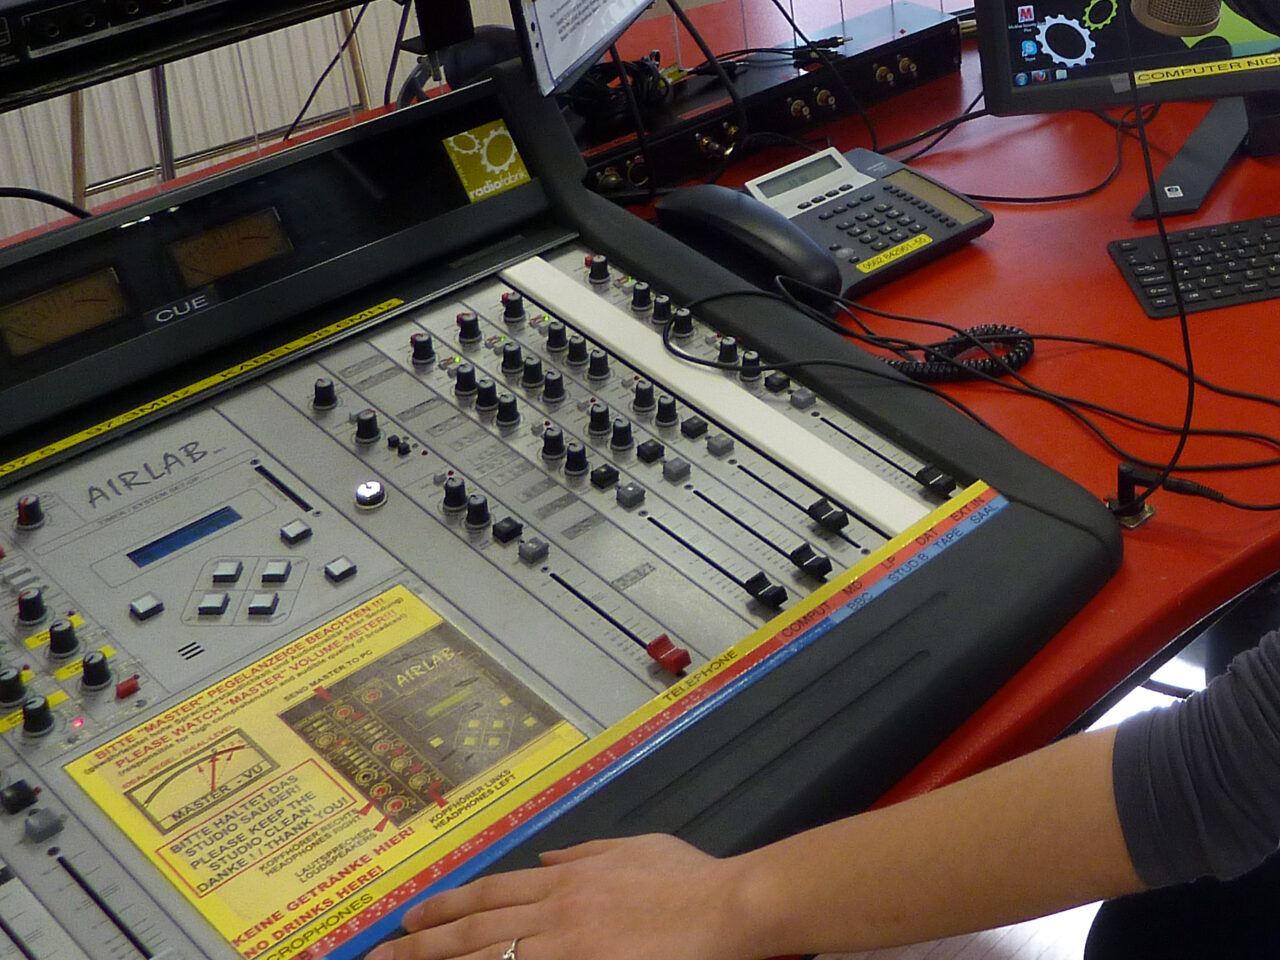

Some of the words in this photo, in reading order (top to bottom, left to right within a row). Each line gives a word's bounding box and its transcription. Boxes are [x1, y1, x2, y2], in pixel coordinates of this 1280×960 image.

[1137, 61, 1242, 81] COMPUTER
[155, 295, 209, 322] CUE
[88, 441, 209, 509] AIRLAB
[933, 528, 963, 549] TAPE
[970, 505, 999, 525] SAAL
[781, 601, 831, 638] COMPUT
[881, 556, 896, 570] LP
[915, 528, 939, 546] DAT
[93, 733, 137, 760] BITTE
[135, 695, 207, 737] "MASTER"
[205, 642, 305, 698] PEGELANZEIGE
[303, 605, 373, 644] BEACHTEN
[307, 664, 347, 687] MASTER
[390, 645, 458, 687] AIRLAB
[662, 649, 737, 703] TELEPHONE
[113, 734, 171, 768] PLEASE
[170, 705, 223, 737] WATCH
[222, 668, 290, 708] "MASTER"
[169, 783, 232, 822] MASTER
[240, 763, 265, 780] VU
[431, 787, 495, 830] HEADPHONES
[492, 773, 517, 790] LEFT
[482, 767, 512, 788] LINKS
[168, 825, 213, 854] BITTE
[211, 792, 269, 828] HALTET
[267, 773, 299, 795] DAS
[183, 821, 240, 858] STUDIO
[237, 783, 303, 824] SAUBER!
[188, 831, 248, 870] PLEASE
[246, 807, 288, 835] KEEP
[285, 789, 317, 811] THE
[207, 835, 264, 872] STUDIO
[262, 803, 316, 838] CLEAN!
[195, 857, 249, 893] DANKE
[263, 817, 314, 850] THANK
[312, 795, 349, 820] YOU!
[263, 831, 334, 877] HEADPHONES
[292, 826, 373, 878] LAUTSPRECHER
[297, 831, 378, 883] LOUDSPEAKERS
[229, 908, 286, 947] KEINE
[282, 852, 374, 913] GETRÄNKE
[371, 825, 416, 856] HIER!
[241, 938, 271, 960] NO
[270, 896, 335, 941] DRINKS
[334, 864, 385, 899] HERE!
